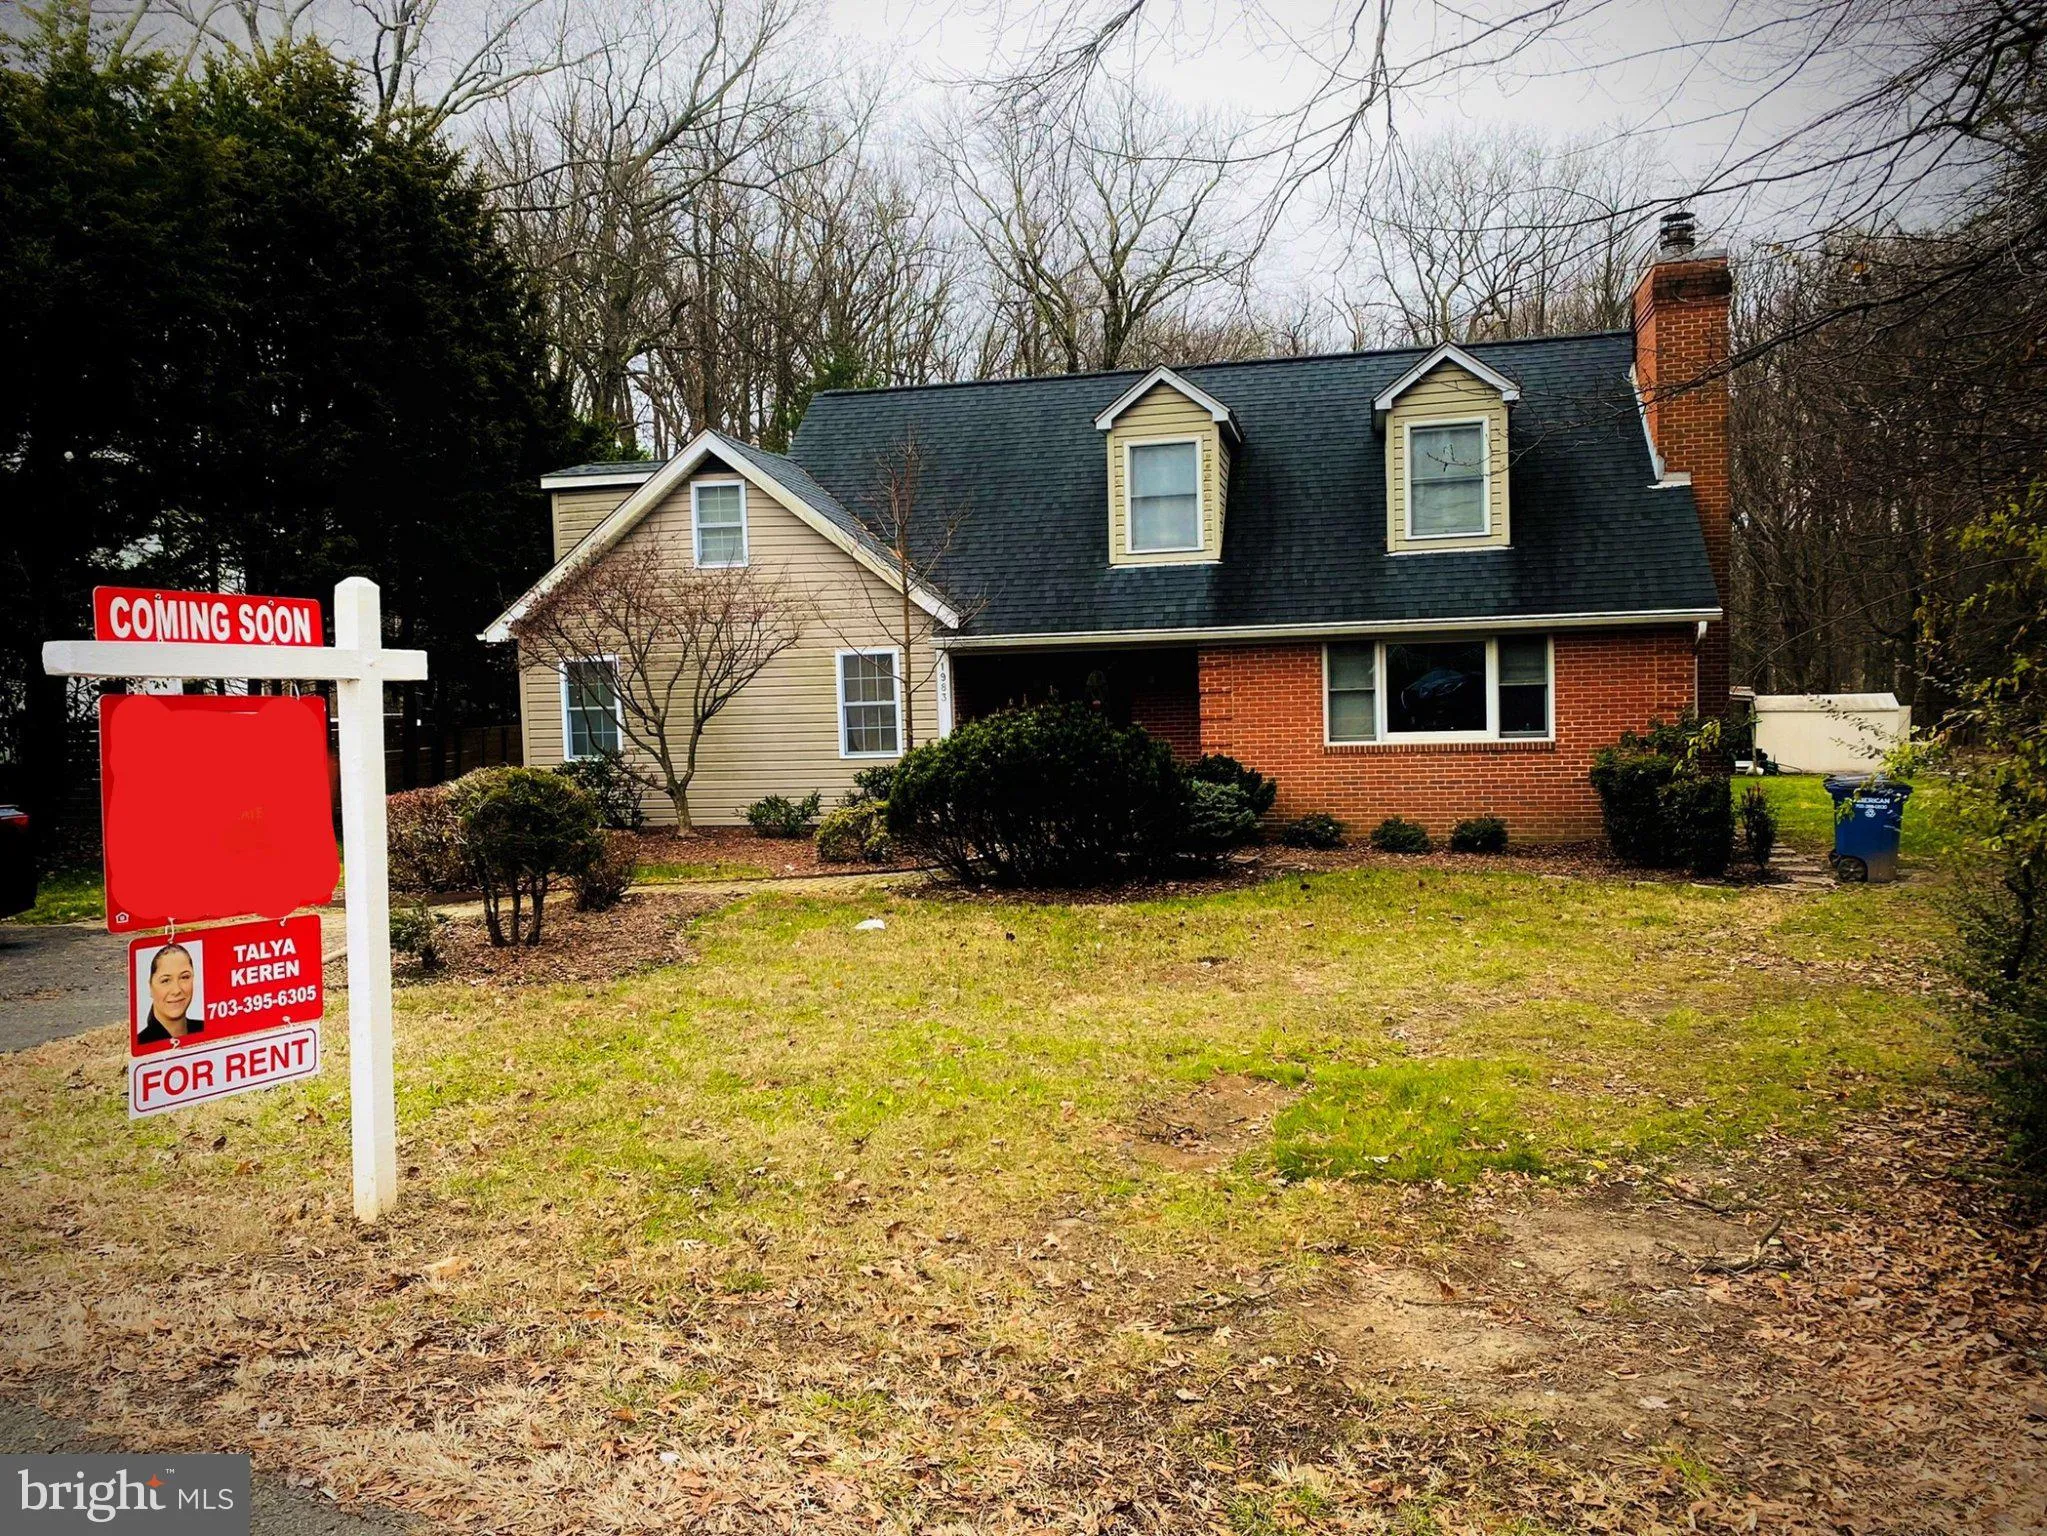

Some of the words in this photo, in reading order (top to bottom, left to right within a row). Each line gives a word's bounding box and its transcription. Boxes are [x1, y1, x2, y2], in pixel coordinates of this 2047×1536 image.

[109, 596, 230, 640] COMING
[238, 603, 311, 643] SOON
[233, 938, 297, 963] TALYA
[231, 960, 300, 988] KEREN
[207, 985, 317, 1020] 703-395-6305
[142, 1059, 214, 1102] FOR
[225, 1038, 309, 1083] RENT
